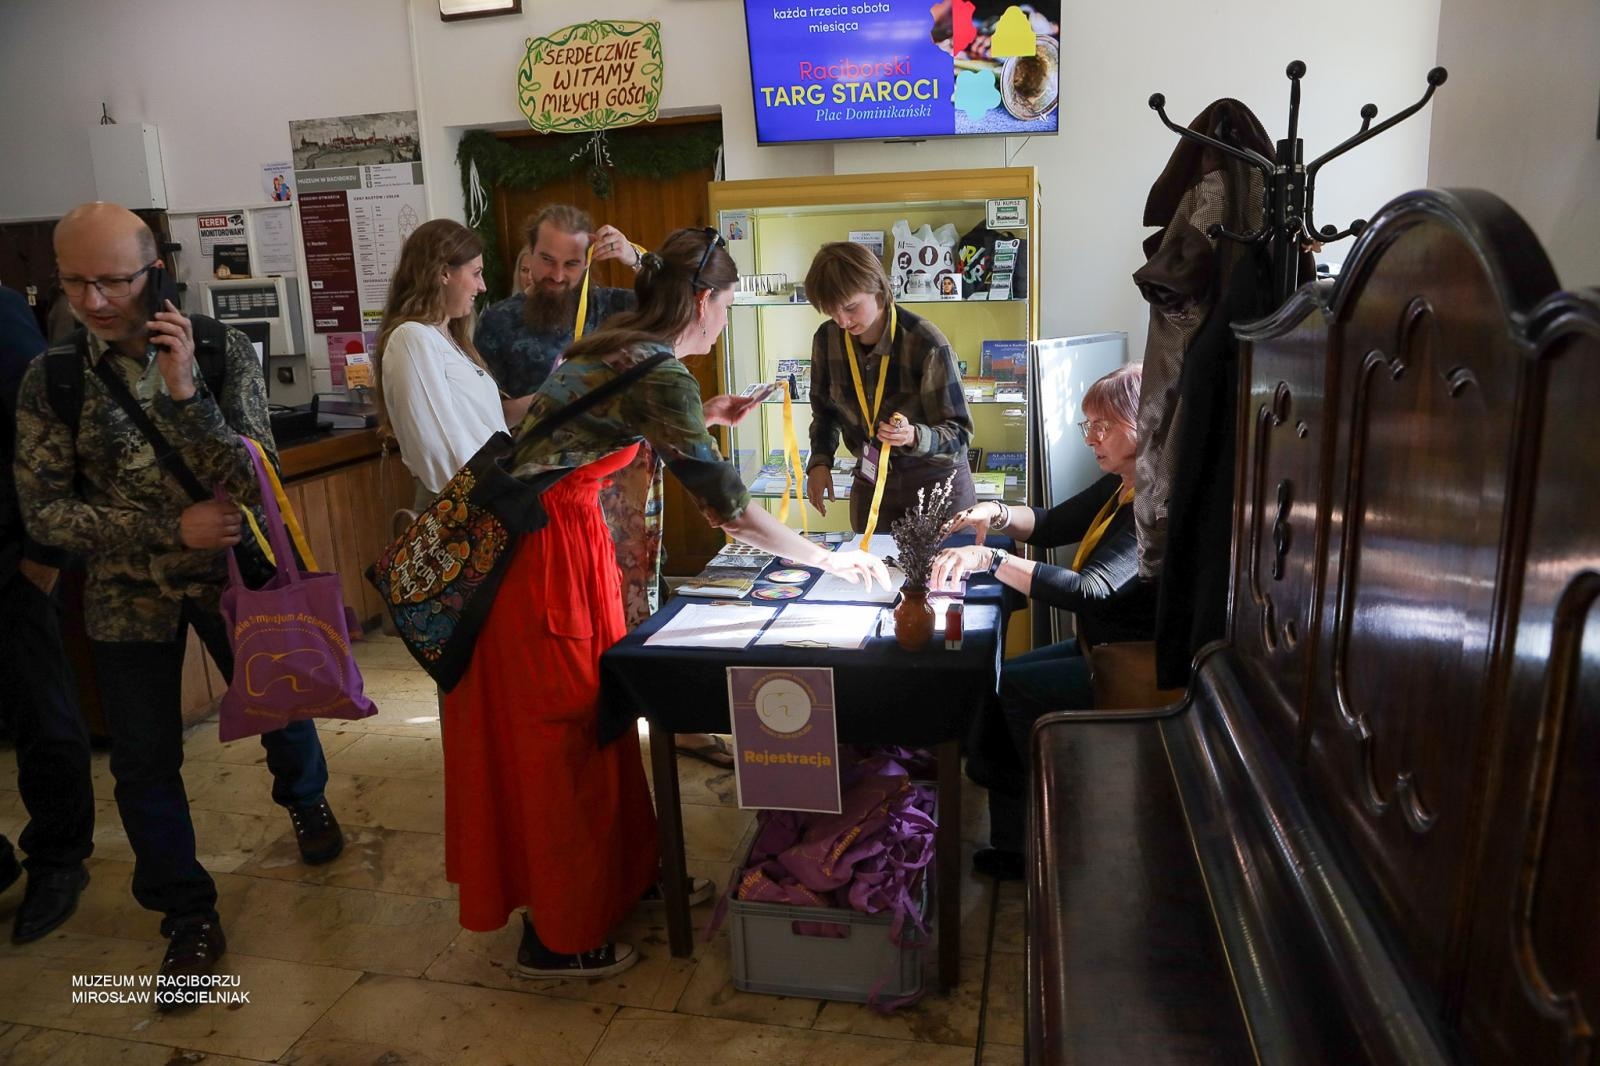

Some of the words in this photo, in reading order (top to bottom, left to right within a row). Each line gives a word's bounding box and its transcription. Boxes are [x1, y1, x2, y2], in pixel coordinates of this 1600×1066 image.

[773, 7, 807, 20] każda
[809, 4, 849, 18] trzecia
[851, 2, 890, 15] sobota
[809, 20, 859, 34] miesiąca
[543, 40, 641, 66] SERDECZNIE
[553, 62, 635, 90] WITAMY
[799, 56, 911, 81] Raciborski
[541, 91, 599, 114] MIŁYCH
[606, 81, 646, 107] GOŚCI
[760, 84, 826, 108] TARG
[831, 79, 940, 104] STAROCI
[815, 108, 843, 122] Plac
[845, 104, 932, 121] Dominikański
[200, 218, 225, 227] TEREN
[200, 228, 245, 237] MONITOROWANY
[743, 749, 832, 768] Rejestracja
